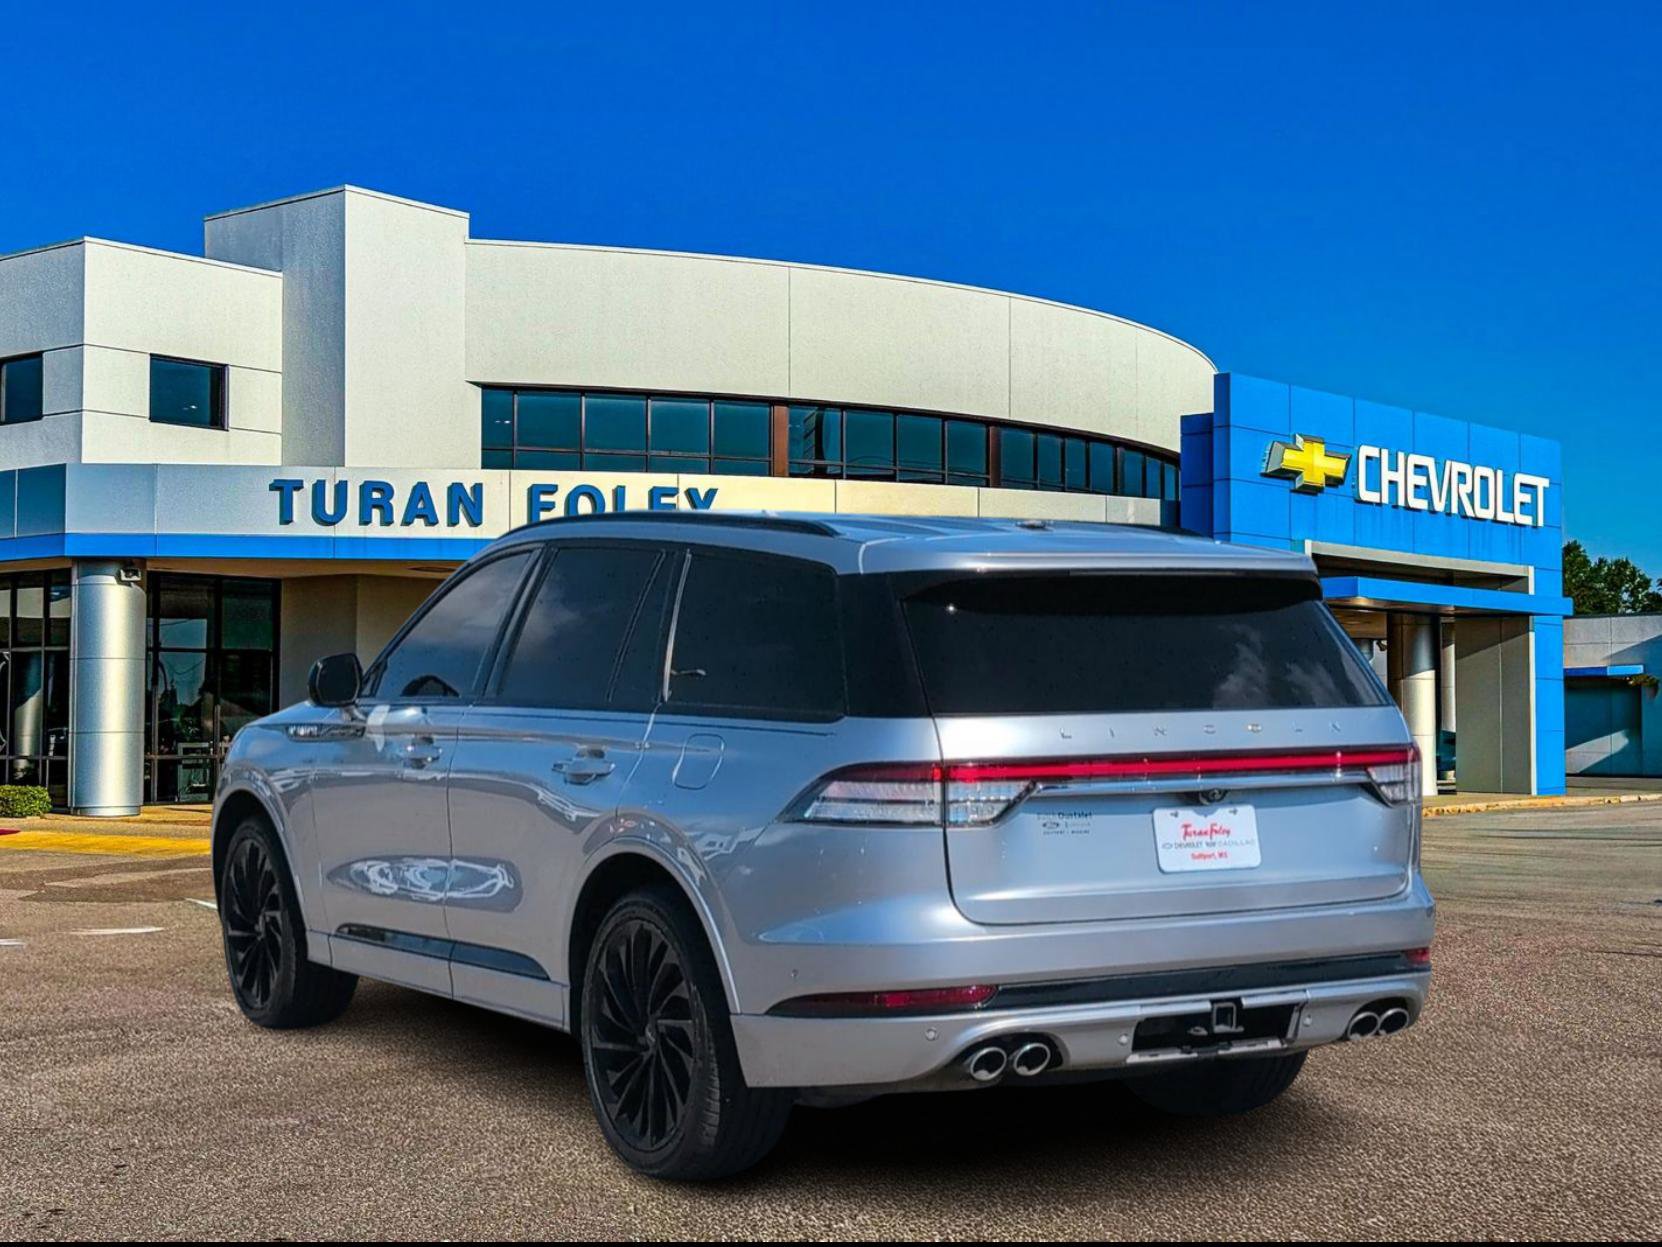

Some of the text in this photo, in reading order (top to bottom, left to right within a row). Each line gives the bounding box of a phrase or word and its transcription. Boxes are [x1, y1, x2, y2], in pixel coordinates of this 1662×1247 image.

[268, 478, 484, 528] TURAN
[1356, 444, 1550, 528] CHEVROLET
[1059, 721, 1341, 739] LINCOLN
